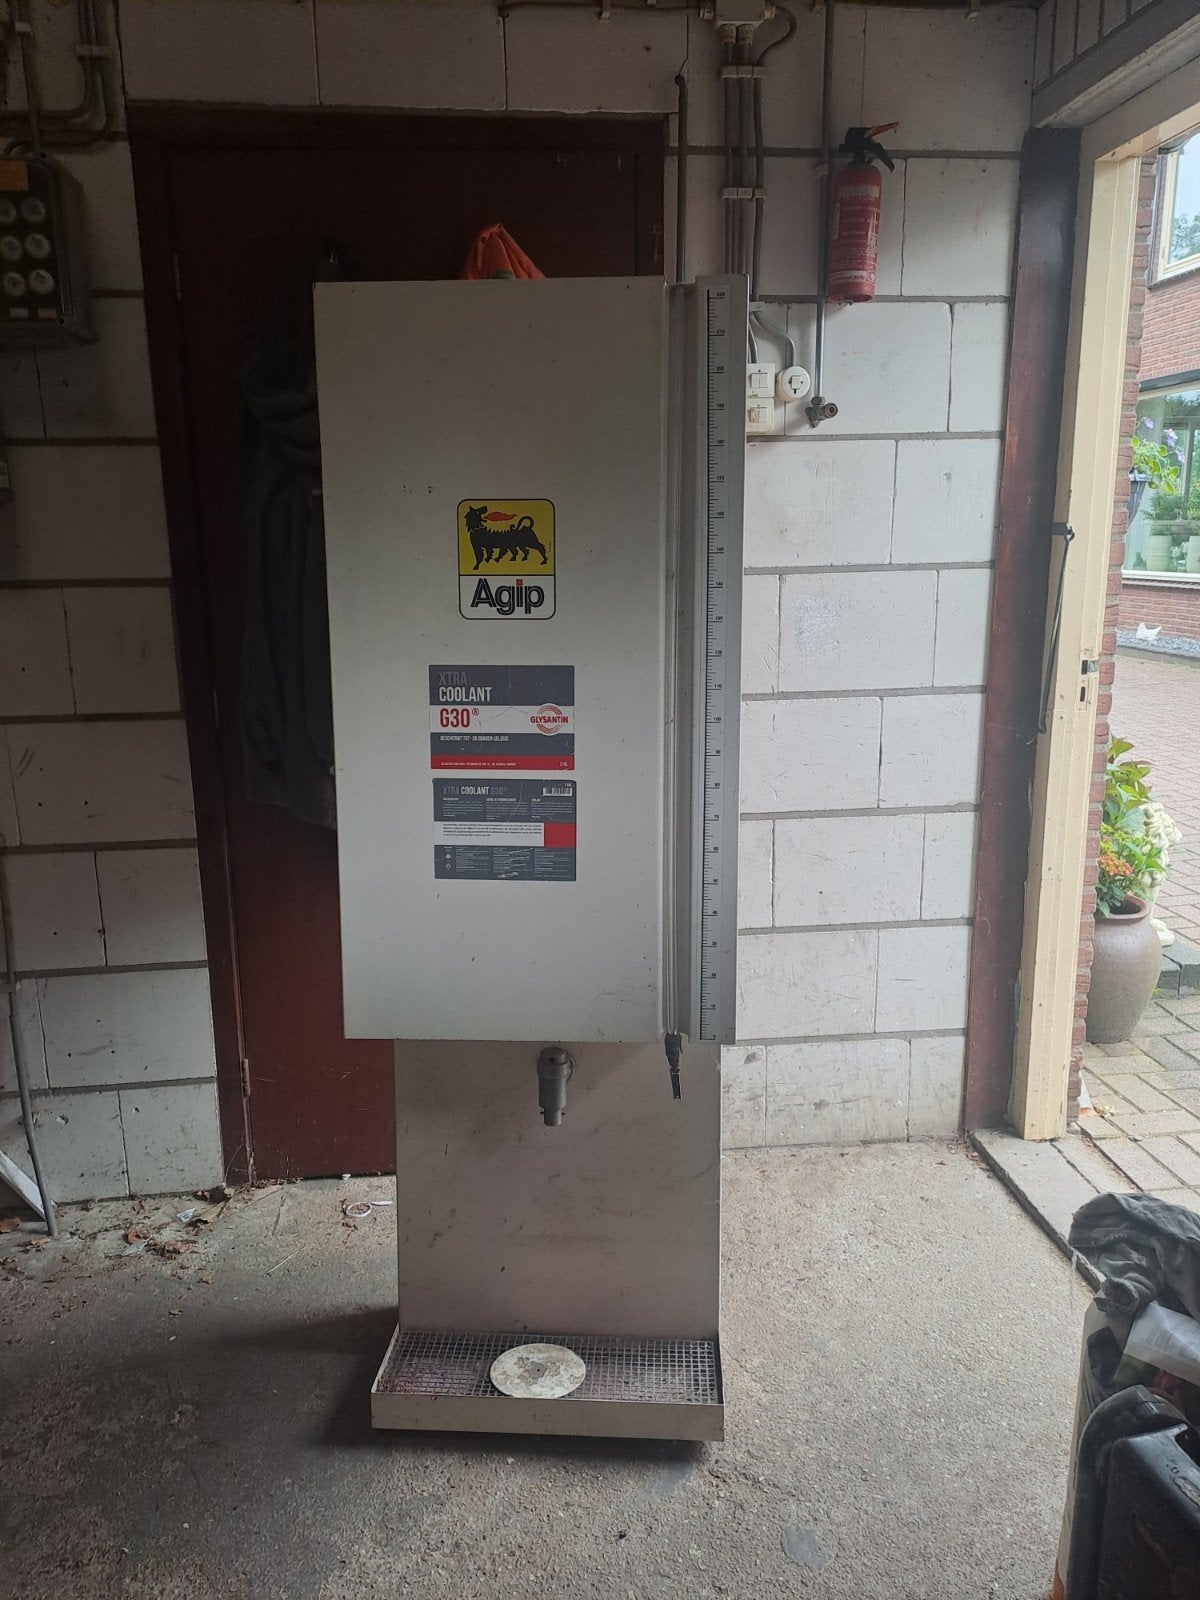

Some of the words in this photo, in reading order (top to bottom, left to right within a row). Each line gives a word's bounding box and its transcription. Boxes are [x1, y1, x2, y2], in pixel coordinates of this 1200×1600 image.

[470, 577, 545, 615] Agip
[439, 671, 467, 685] XTRA
[439, 686, 492, 702] COOLANT
[530, 716, 569, 724] GLYSANTIN
[442, 786, 459, 795] XTRA
[460, 786, 490, 795] COOLANT
